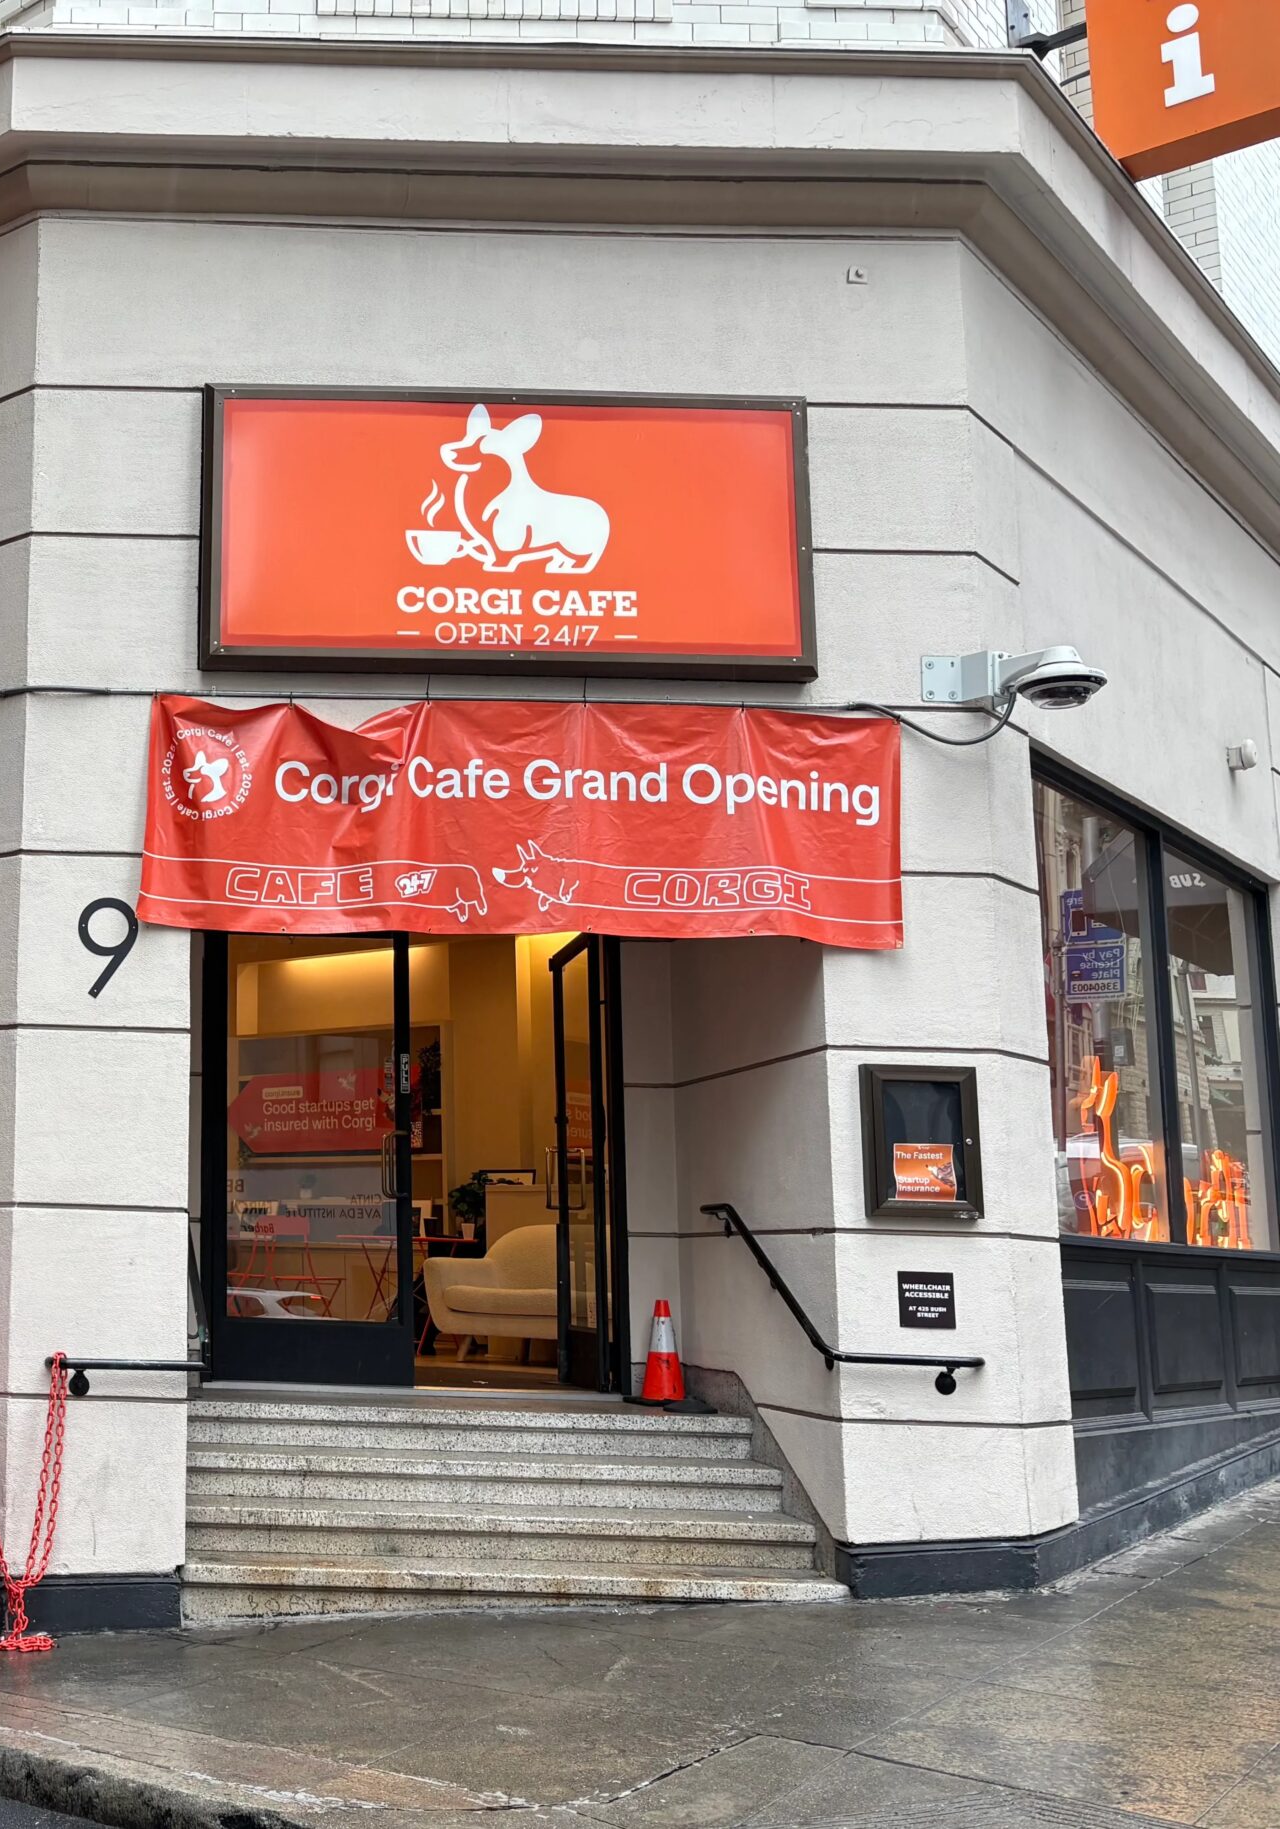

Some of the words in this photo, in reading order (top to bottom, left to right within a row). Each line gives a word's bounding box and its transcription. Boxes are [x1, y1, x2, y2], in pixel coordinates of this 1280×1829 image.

[396, 585, 523, 616] CORGI
[531, 589, 638, 617] CAFE
[434, 622, 524, 645] OPEN
[533, 624, 600, 647] 24/7
[176, 726, 205, 740] Corgi
[207, 729, 233, 747] Cafe
[235, 750, 250, 771] Est.
[162, 777, 176, 800] Est.
[235, 773, 253, 804] 2025
[275, 760, 399, 813] Corgi
[407, 755, 511, 799] Cafe
[523, 758, 668, 803] Grand
[681, 762, 881, 827] Opening
[176, 803, 199, 820] Cafe
[201, 805, 234, 821] Corgi
[225, 866, 373, 904] CAFE
[624, 871, 811, 911] CORGI
[78, 897, 139, 999] 9
[262, 1101, 296, 1115] Good
[298, 1099, 350, 1114] startups
[353, 1097, 375, 1114] get
[264, 1117, 309, 1132] insured
[311, 1115, 339, 1129] with
[341, 1113, 376, 1132] Corgi
[896, 1151, 912, 1159] The
[913, 1151, 944, 1160] Fastest
[897, 1176, 930, 1185] Startup
[899, 1185, 941, 1193] Insurance
[901, 1283, 951, 1291] WHEELCHAIR
[904, 1291, 950, 1299] ACCESSIBLE
